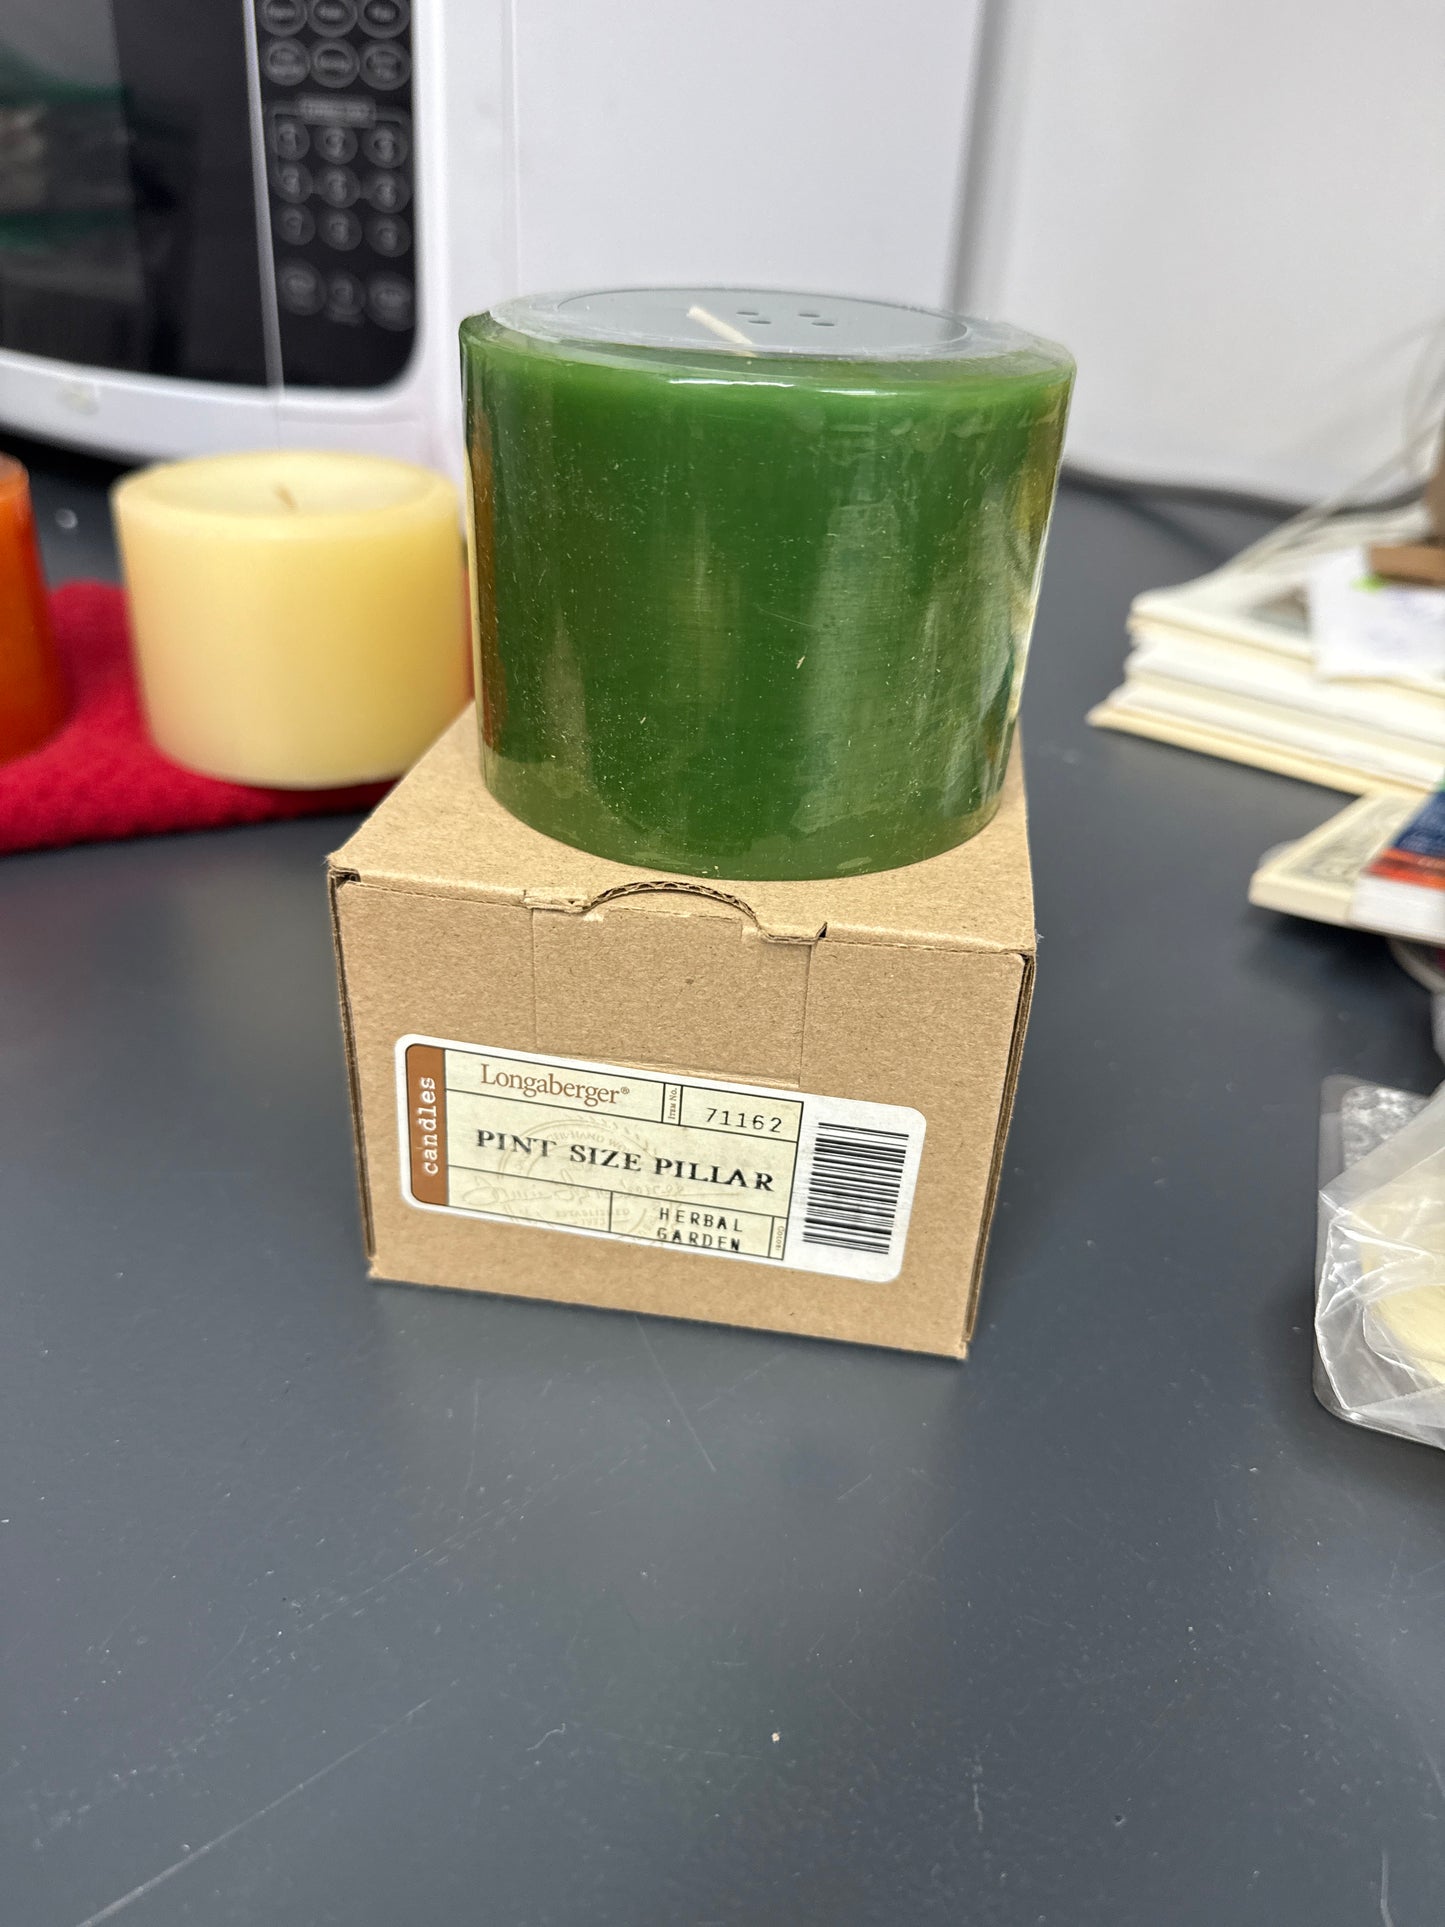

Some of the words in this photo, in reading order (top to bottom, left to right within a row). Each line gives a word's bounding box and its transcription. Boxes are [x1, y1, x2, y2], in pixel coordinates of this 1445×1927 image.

[418, 1077, 439, 1176] candles
[706, 1107, 782, 1133] 71162
[477, 1129, 557, 1157] PINT
[569, 1144, 643, 1172] SIZE
[654, 1157, 775, 1192] PILLAR
[659, 1207, 743, 1232] HERBAL
[656, 1227, 741, 1252] GARDEN
